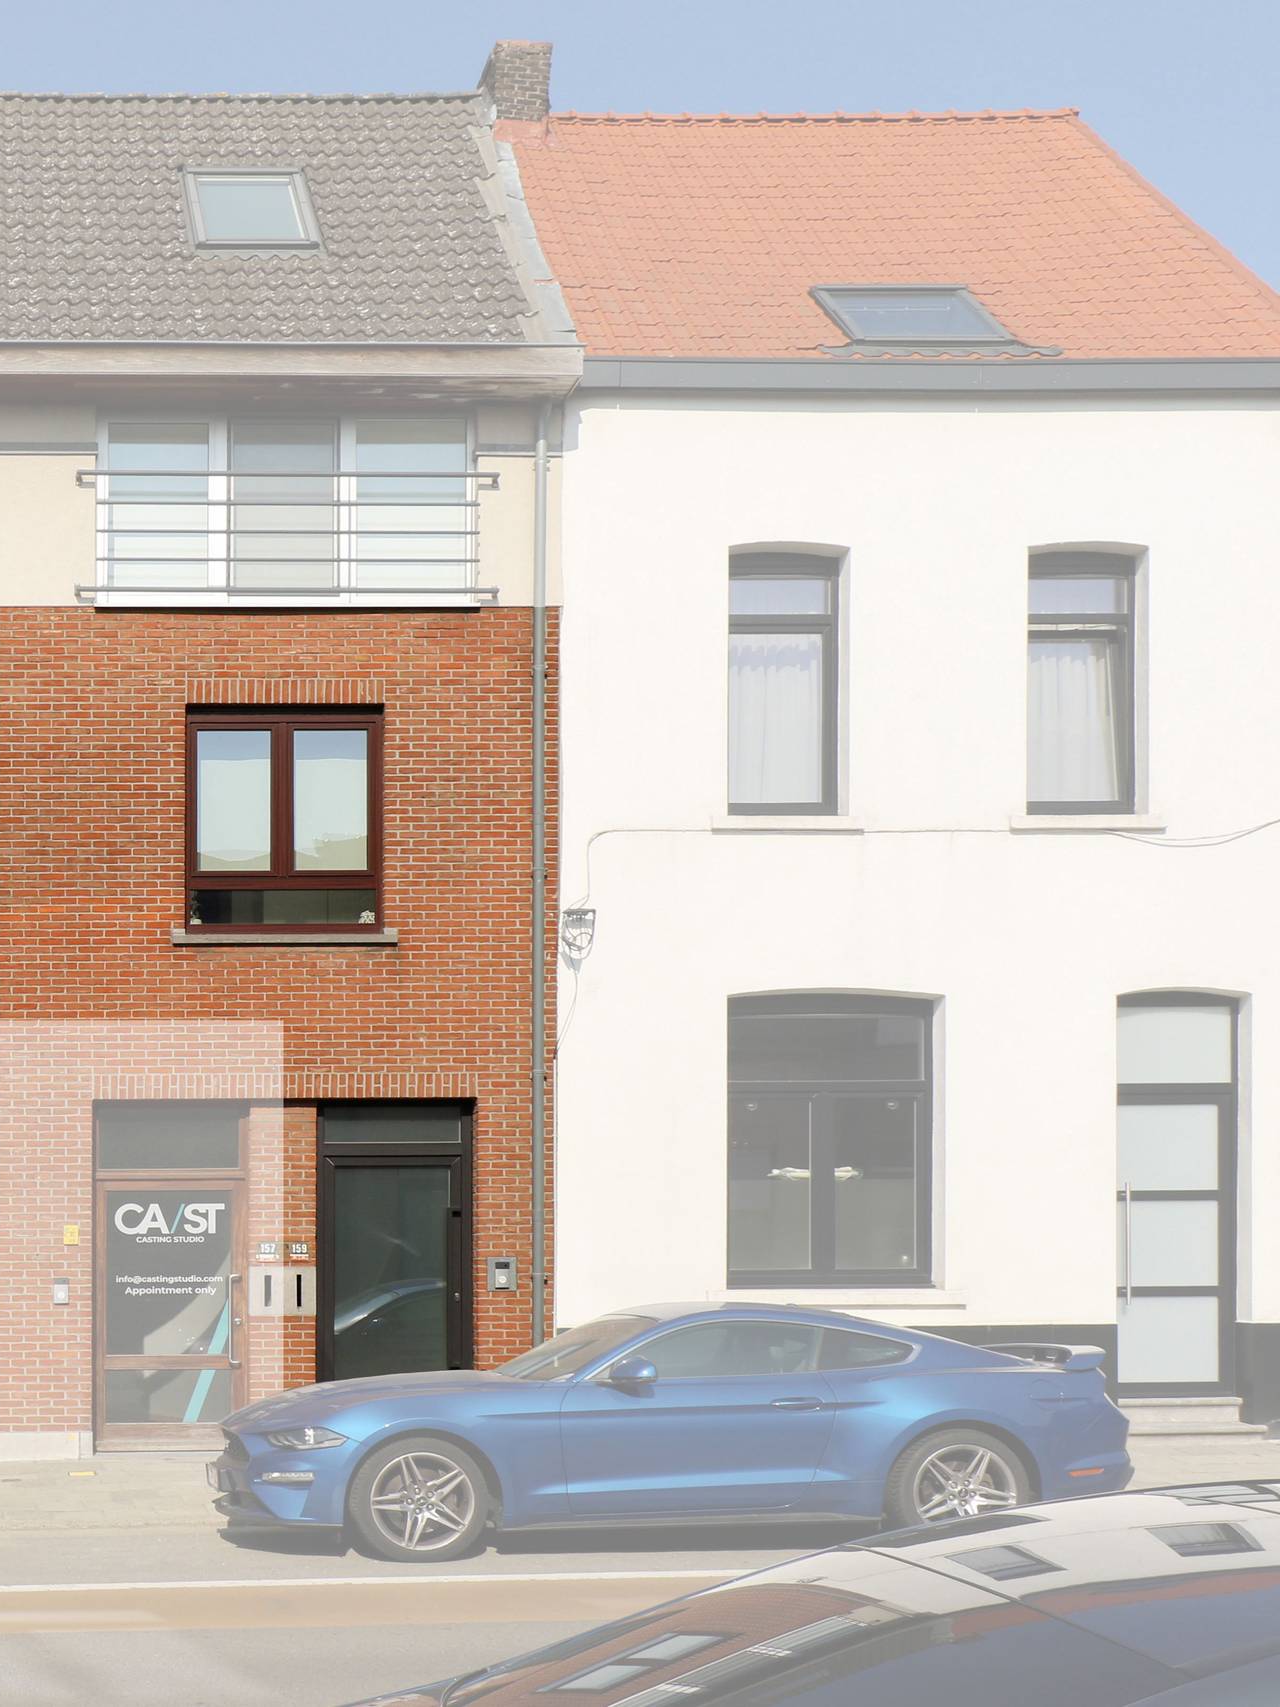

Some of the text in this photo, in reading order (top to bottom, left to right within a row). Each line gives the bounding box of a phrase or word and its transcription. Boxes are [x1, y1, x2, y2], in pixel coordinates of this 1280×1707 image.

[261, 1243, 276, 1254] 157
[292, 1243, 308, 1254] 159
[115, 1275, 224, 1284] info@castingstudio.com
[125, 1286, 217, 1296] Appointment only
